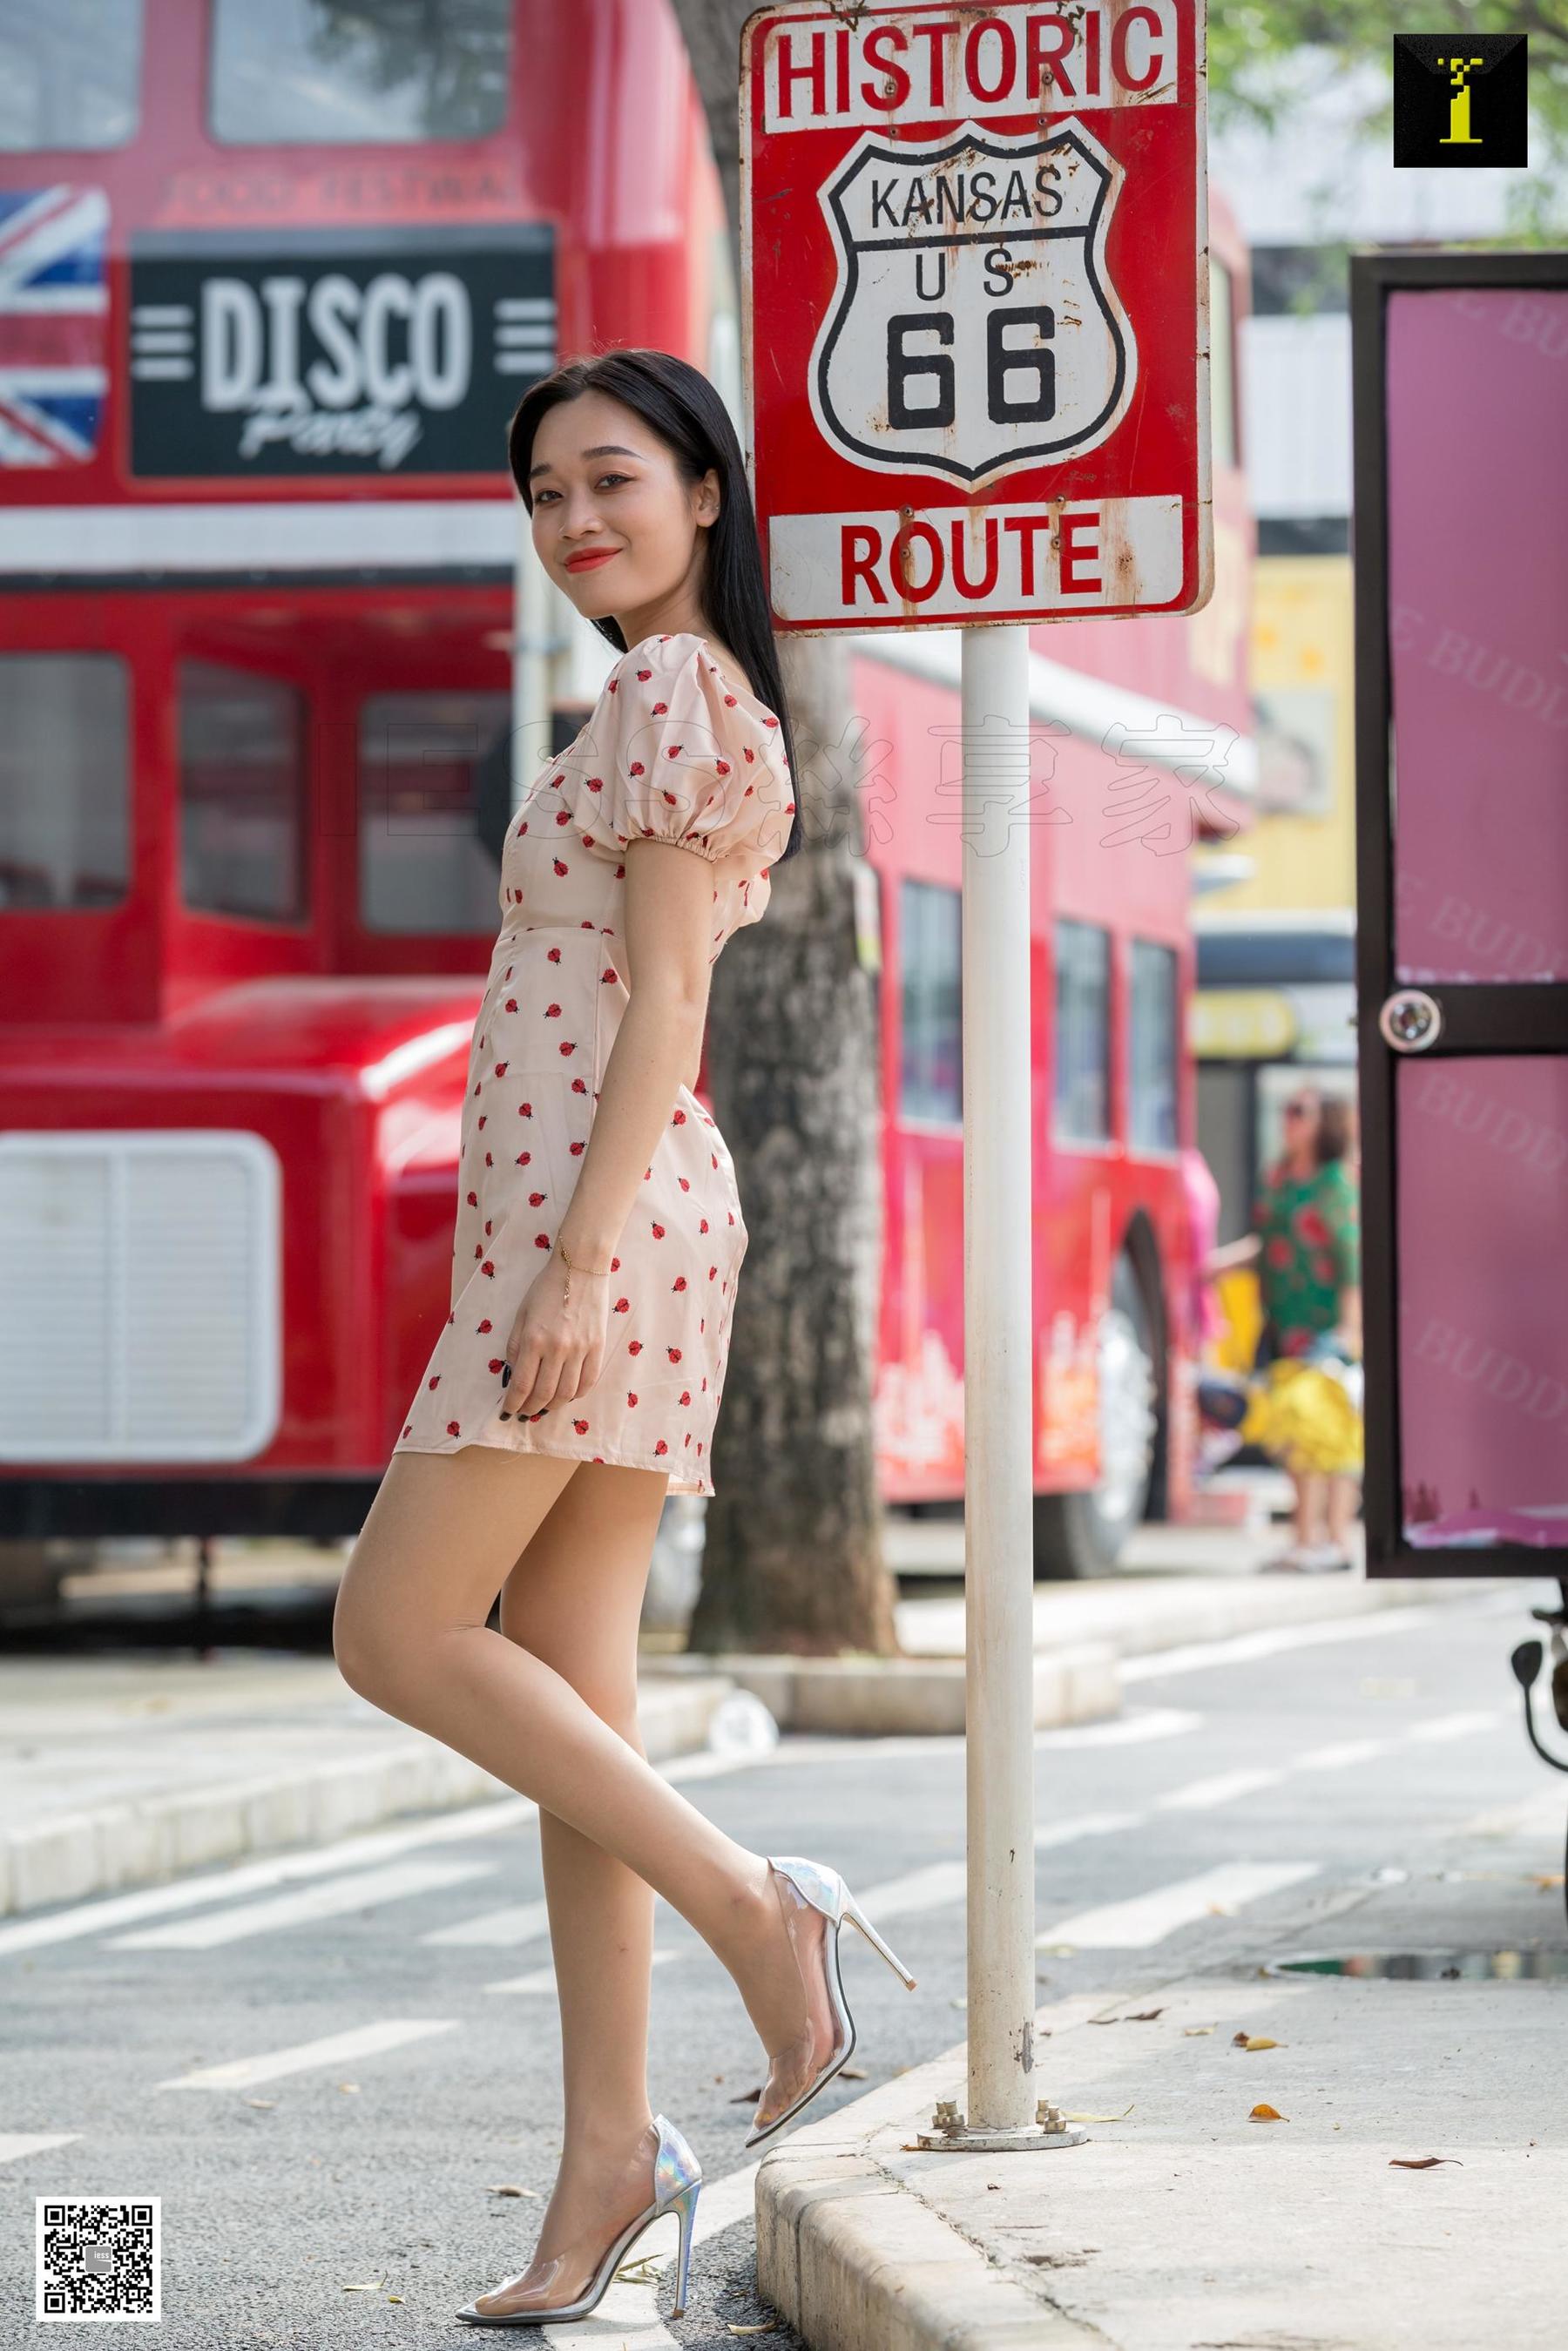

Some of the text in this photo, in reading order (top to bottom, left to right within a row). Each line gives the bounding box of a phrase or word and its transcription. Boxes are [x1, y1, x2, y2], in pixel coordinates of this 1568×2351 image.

[775, 6, 1164, 118] HISTORIC
[871, 166, 1063, 228] KANSAS
[916, 248, 1014, 301] U S
[200, 274, 472, 412] DISCO
[887, 305, 1056, 430] 66
[841, 511, 1103, 606] ROUTE
